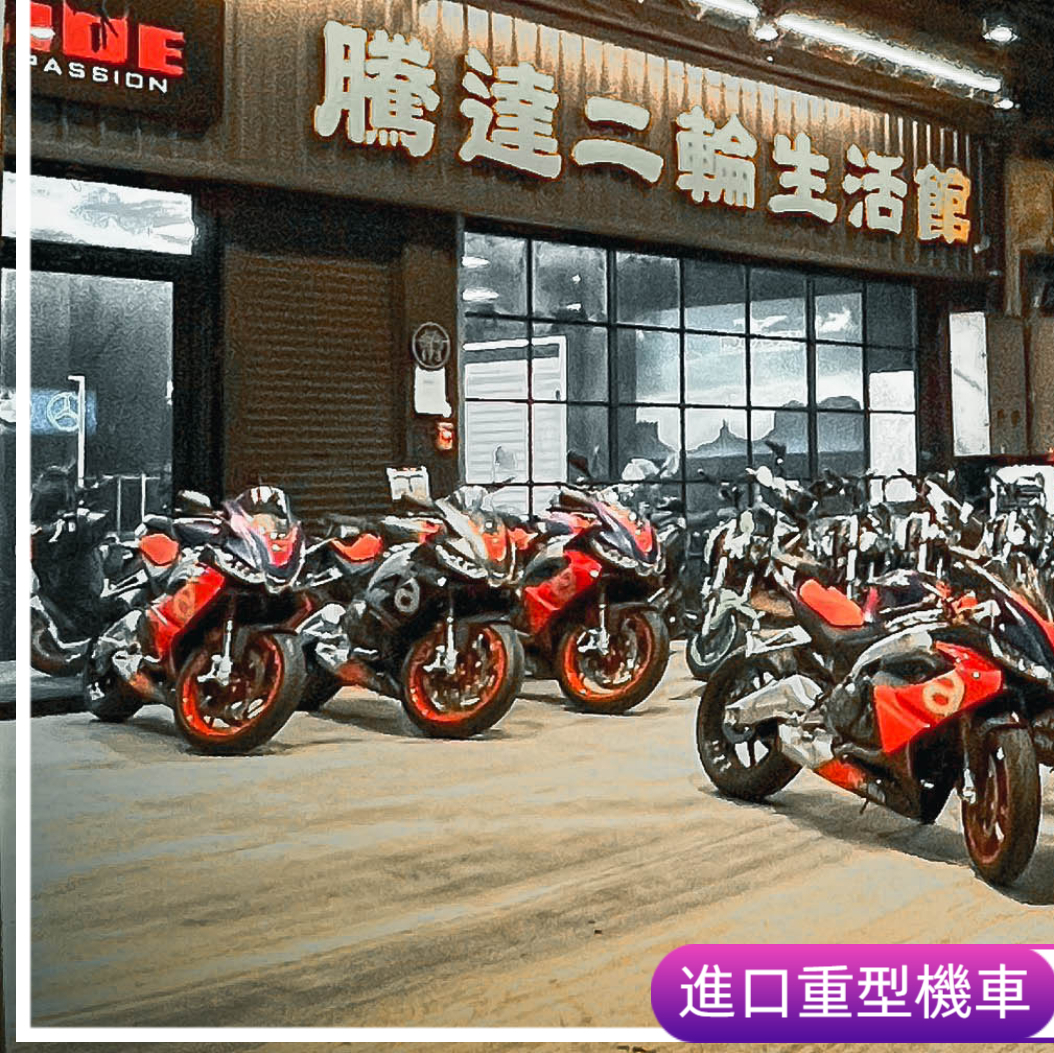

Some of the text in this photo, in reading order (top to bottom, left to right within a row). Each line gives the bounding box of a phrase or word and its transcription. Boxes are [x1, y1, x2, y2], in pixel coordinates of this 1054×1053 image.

[313, 19, 972, 244] 騰達二輪生活館
